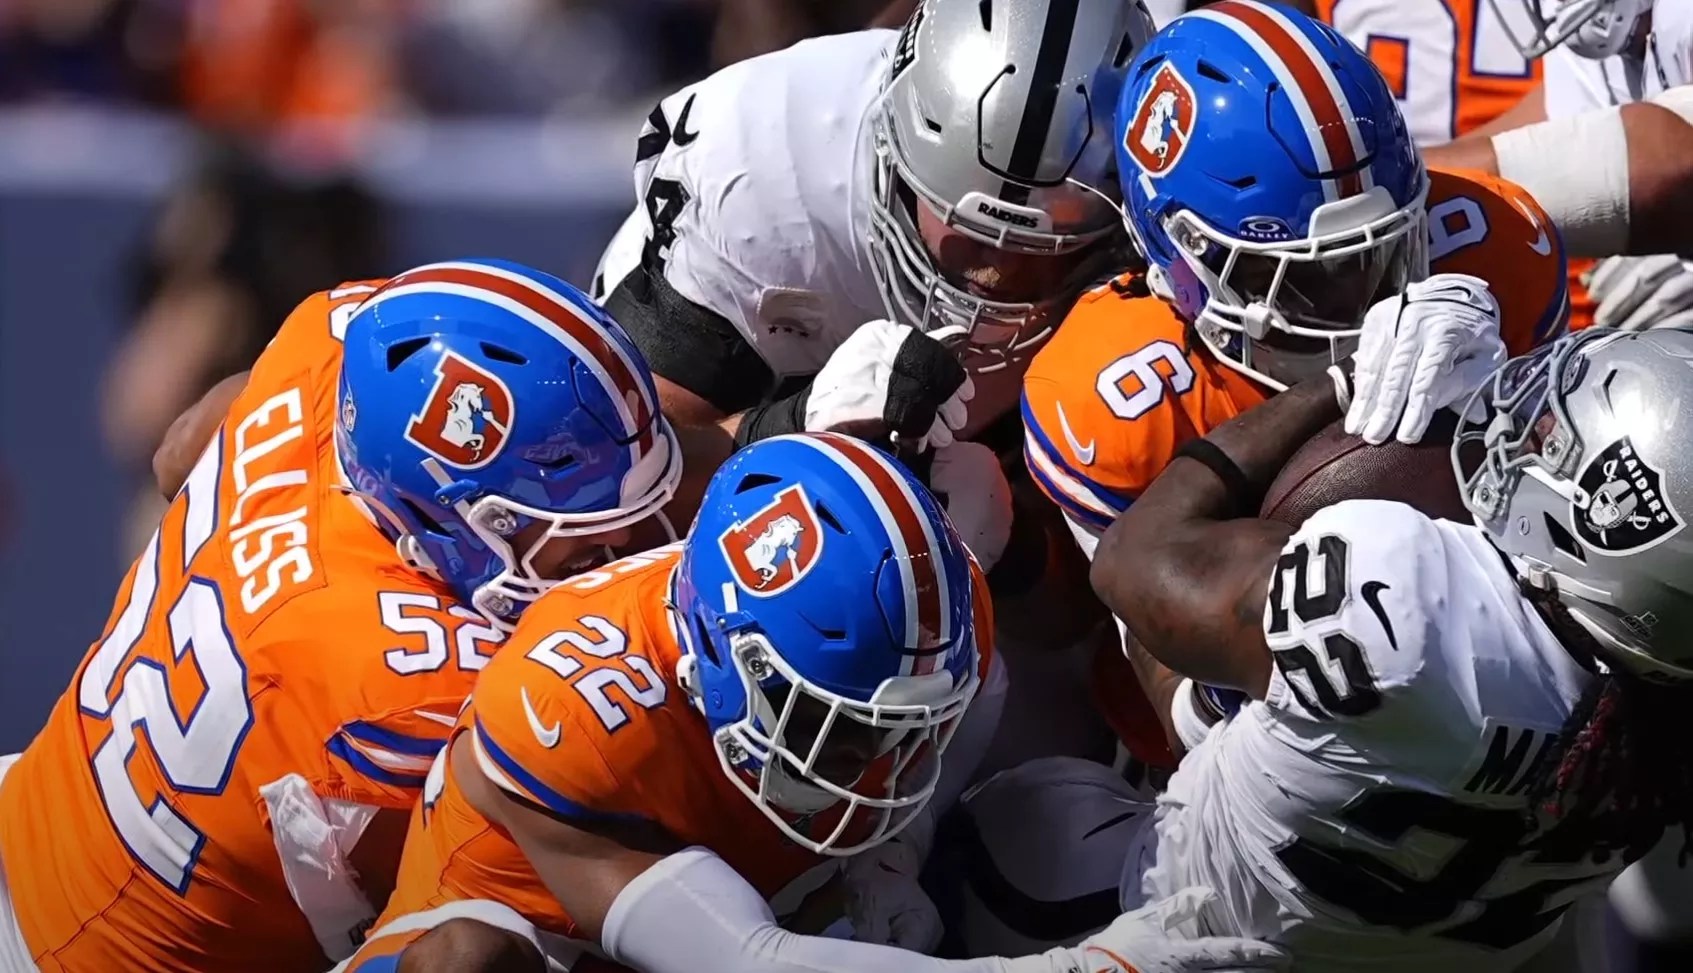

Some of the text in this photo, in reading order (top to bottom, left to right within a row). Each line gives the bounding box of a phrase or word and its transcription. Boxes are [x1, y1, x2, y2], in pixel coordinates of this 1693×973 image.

[977, 202, 1039, 228] RAIDERS
[1095, 339, 1196, 421] 6
[232, 387, 313, 615] ELLISS
[1619, 443, 1669, 524] RAIDERS
[79, 427, 255, 896] 52
[376, 590, 510, 676] 52
[525, 614, 668, 735] 22
[1266, 535, 1385, 723] 22
